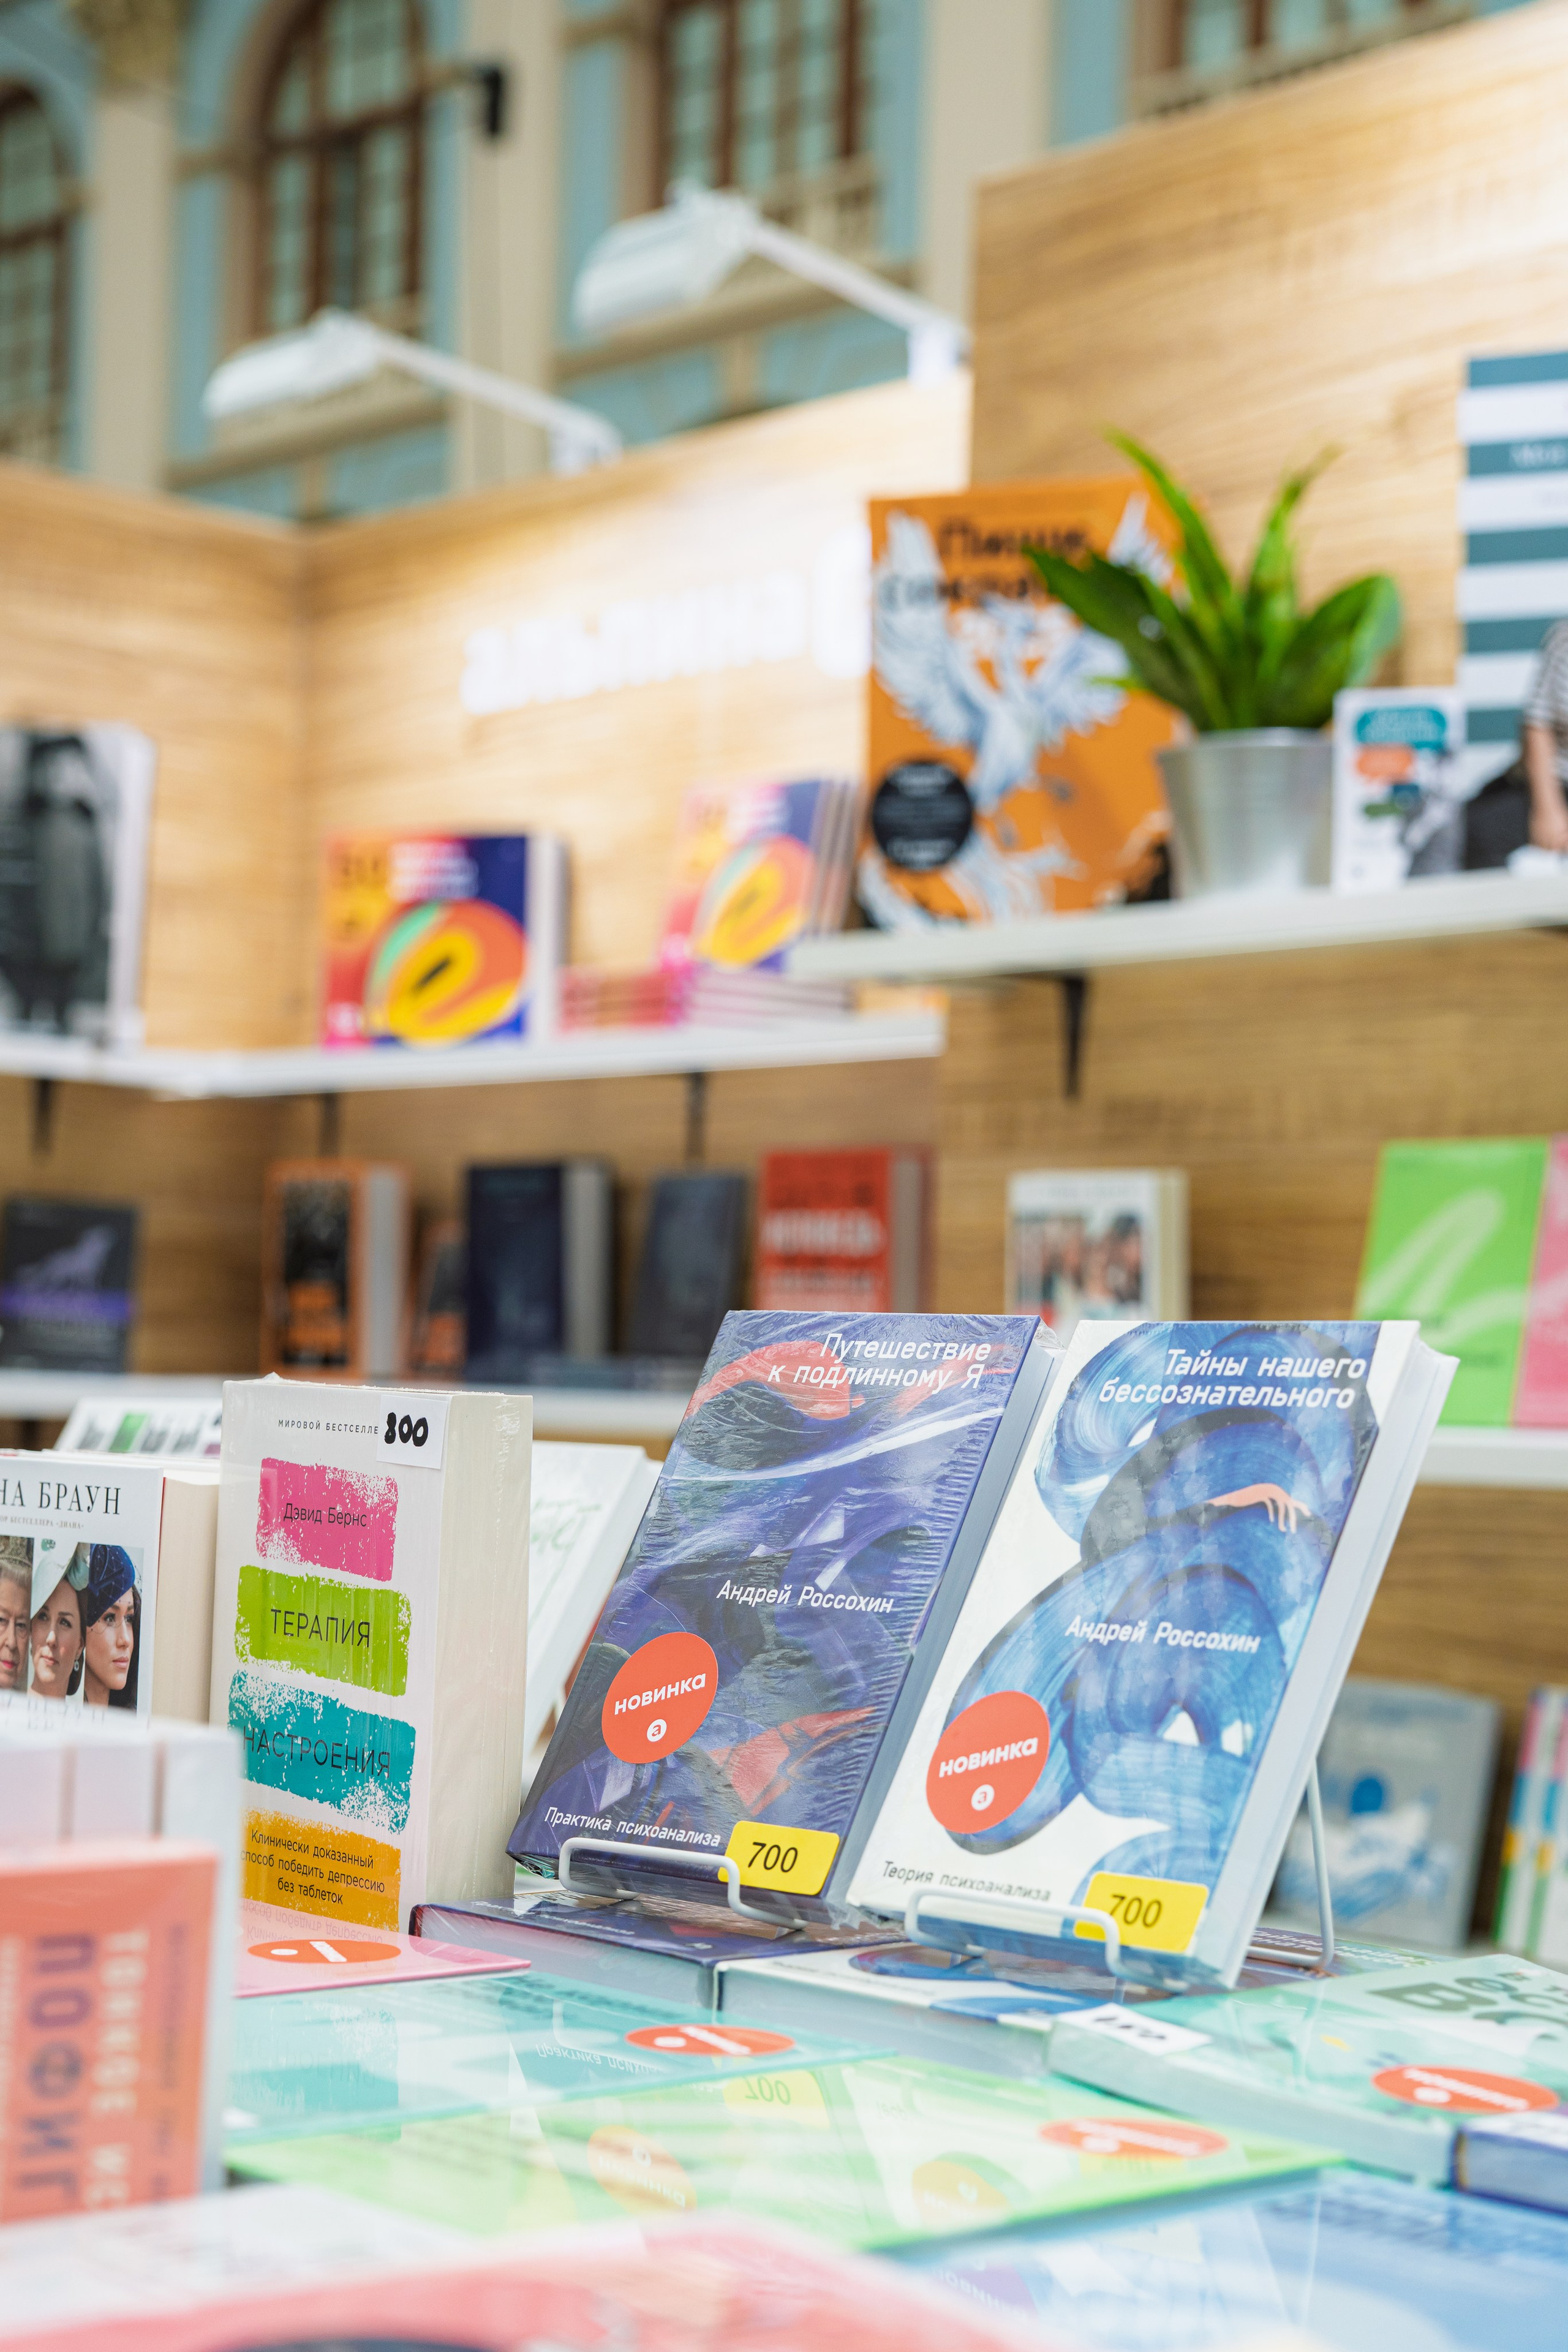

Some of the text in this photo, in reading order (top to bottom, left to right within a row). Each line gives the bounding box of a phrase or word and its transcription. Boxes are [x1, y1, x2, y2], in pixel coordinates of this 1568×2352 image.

[820, 1333, 991, 1363] Путешествие
[1164, 1349, 1366, 1378] Тайны нашего
[767, 1364, 986, 1394] к подлинному Я
[1099, 1377, 1355, 1409] бессознательного
[278, 1419, 379, 1434] МИРОВОЙ БЕСТСЕЛЛЕ
[384, 1412, 429, 1447] 800
[37, 1481, 121, 1515] БРАУН
[284, 1503, 367, 1528] Дэвид Бернс
[716, 1580, 894, 1613] Андрей Россохин
[271, 1608, 371, 1648] ТЕРАПИЯ
[1065, 1615, 1261, 1654] Андрей Россохин
[243, 1725, 391, 1778] НАСТРОЕНИЯ
[544, 1806, 722, 1847] Практика психоанализа
[251, 1829, 374, 1869] Клинически доказанный
[747, 1842, 798, 1873] 700
[240, 1850, 385, 1893] способ победить депрессию
[882, 1860, 1051, 1902] Теория психоанализа
[277, 1877, 343, 1905] без таблеток
[1110, 1893, 1163, 1928] 700
